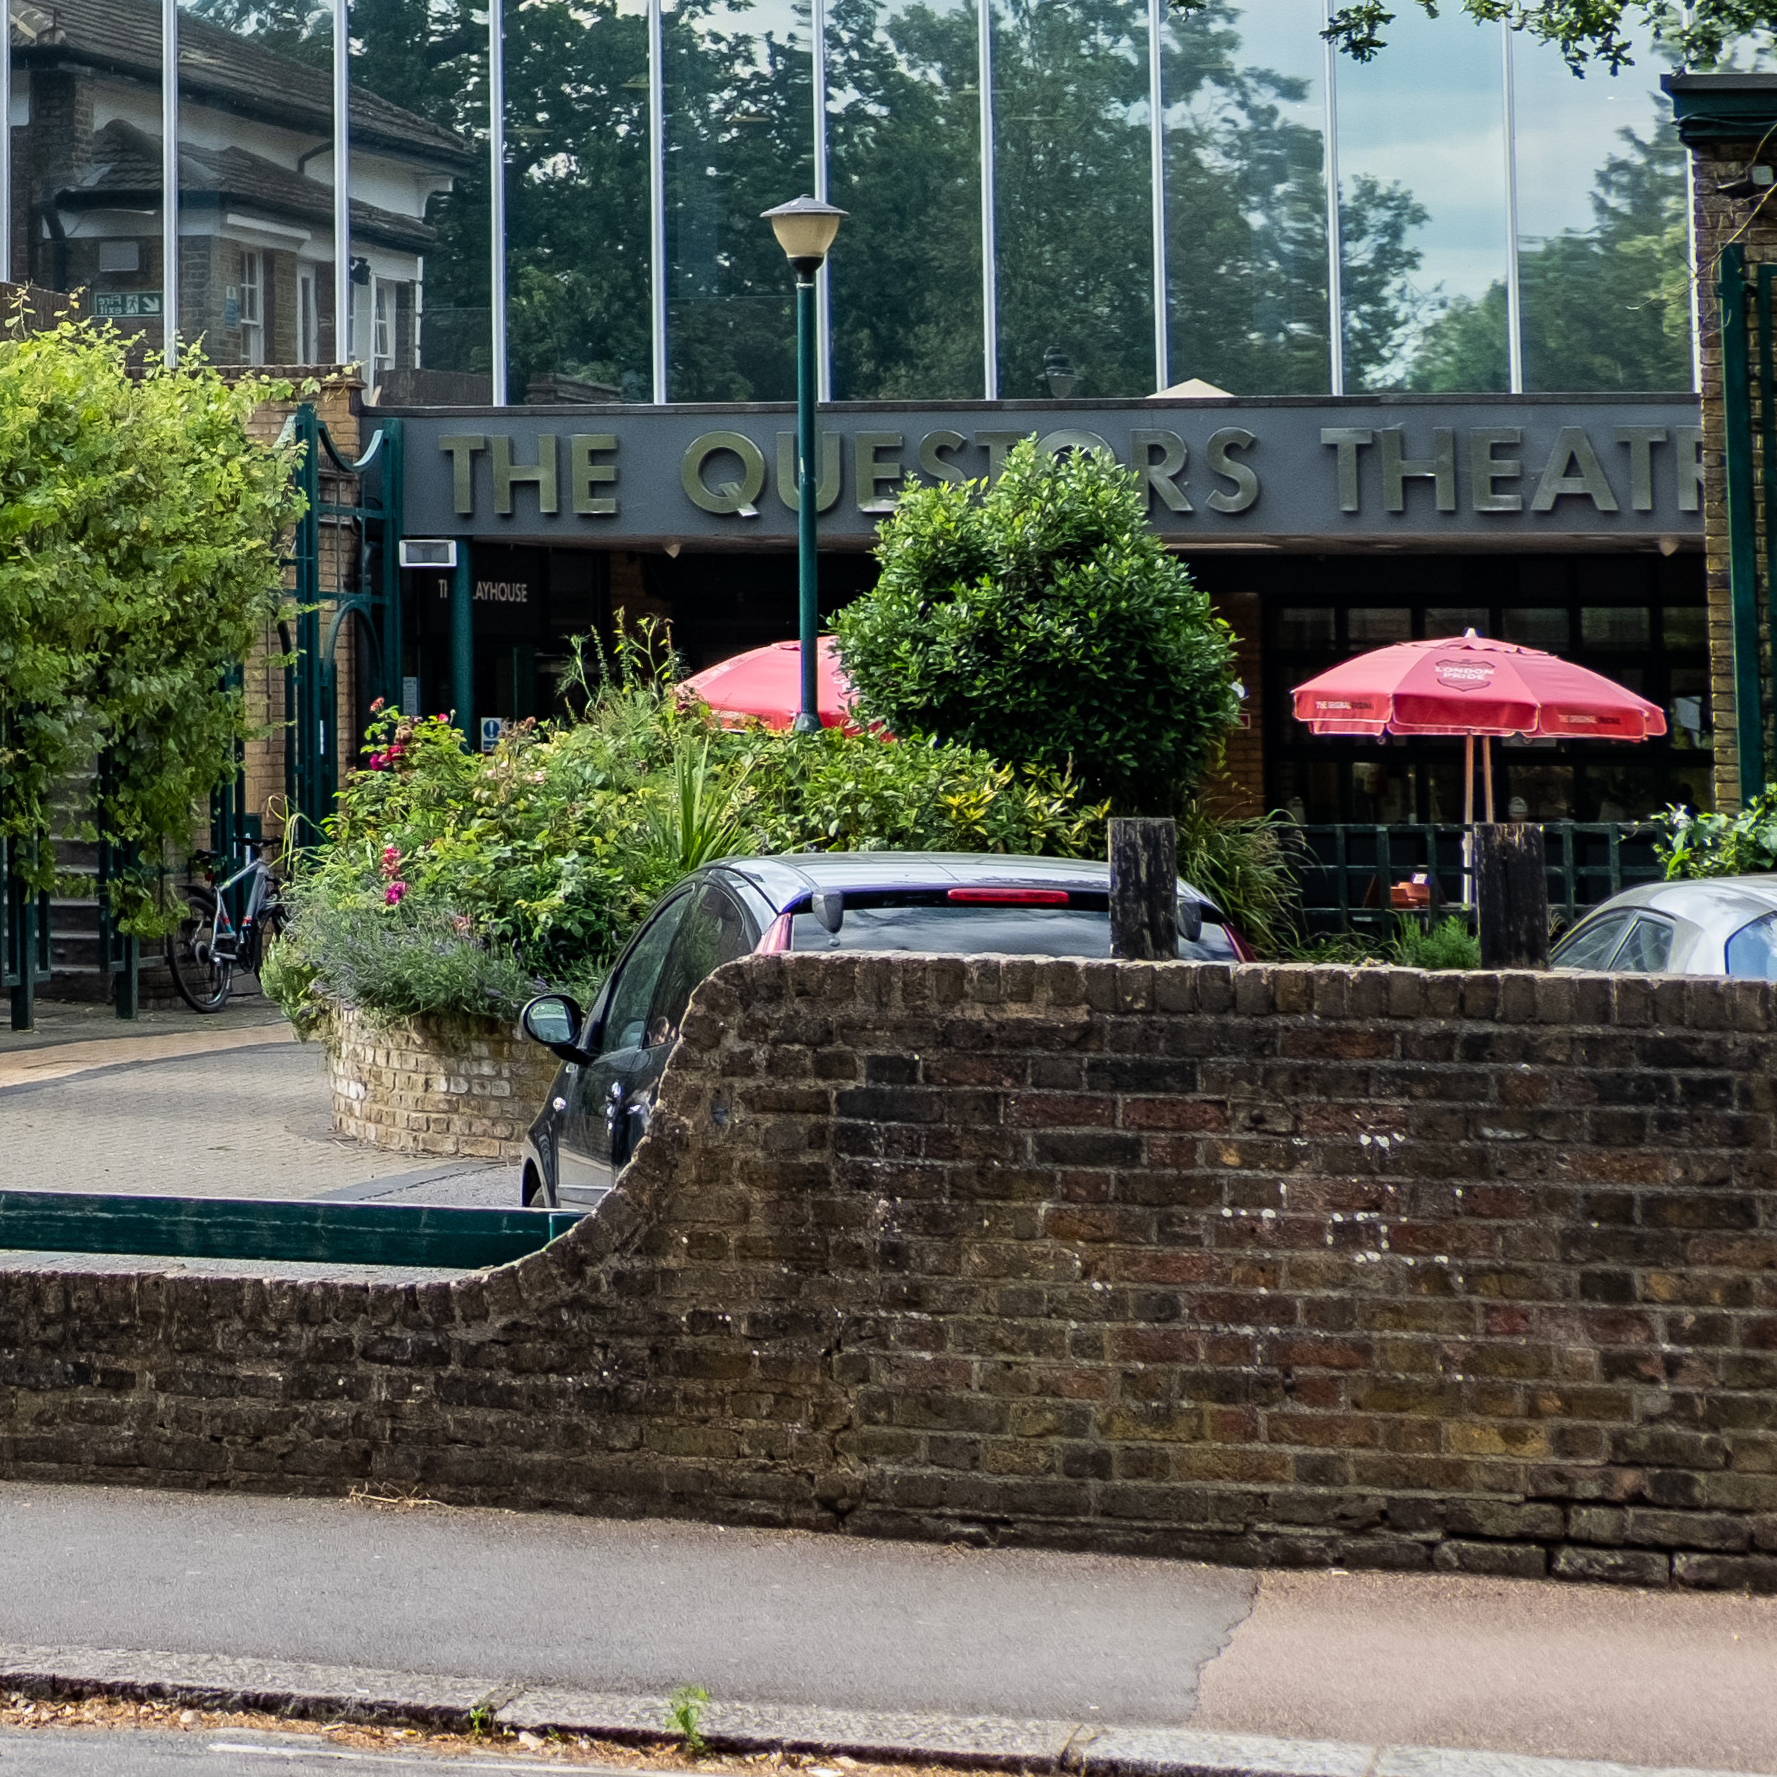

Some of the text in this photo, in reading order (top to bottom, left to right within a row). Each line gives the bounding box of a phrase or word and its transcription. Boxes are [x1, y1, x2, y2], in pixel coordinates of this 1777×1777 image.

[438, 433, 619, 514] THE
[472, 580, 528, 603] AYHOUSE
[1435, 666, 1495, 675] LONDON
[1442, 672, 1485, 681] PRIDE
